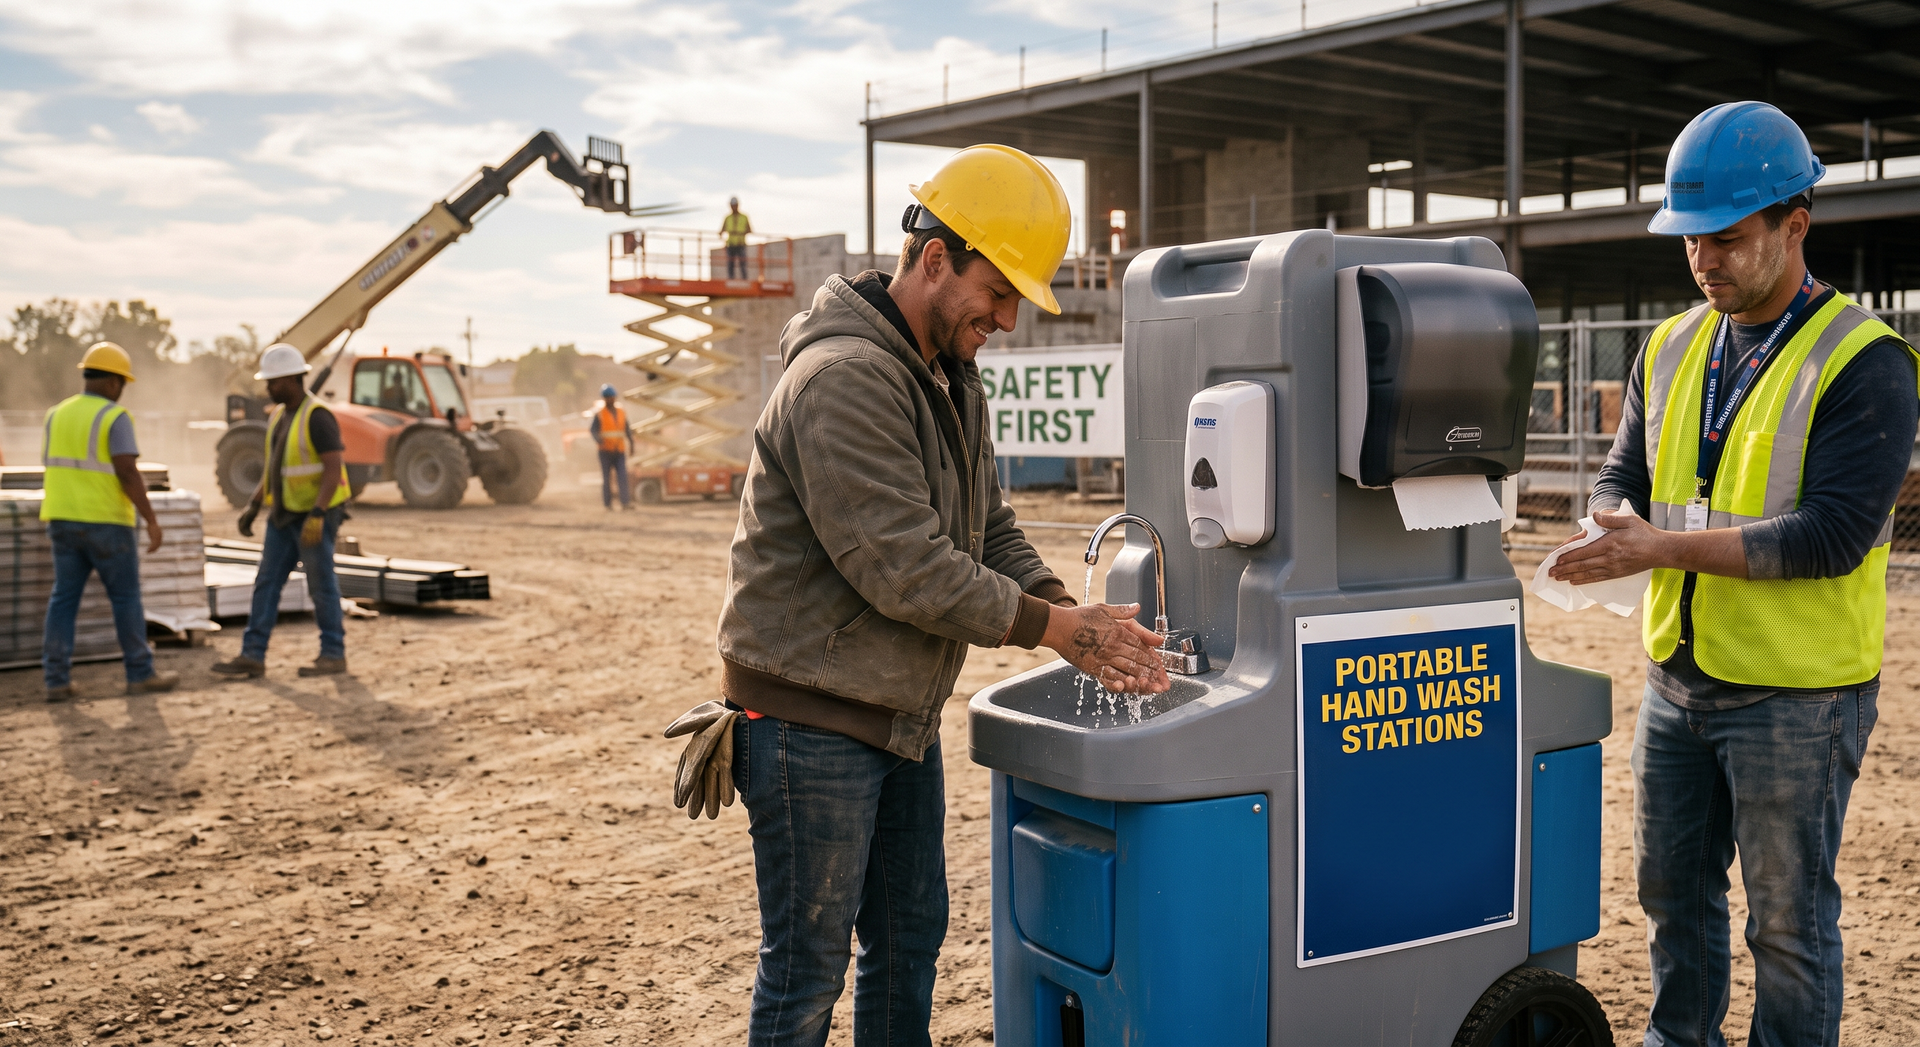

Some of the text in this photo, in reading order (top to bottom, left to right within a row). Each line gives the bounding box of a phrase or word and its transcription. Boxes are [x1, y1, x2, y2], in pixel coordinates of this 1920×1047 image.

[980, 363, 1112, 400] SAFETY
[996, 409, 1095, 443] FIRST
[1335, 643, 1488, 687] PORTABLE
[1321, 674, 1501, 723] HAND WASH
[1341, 709, 1484, 754] STATIONS
